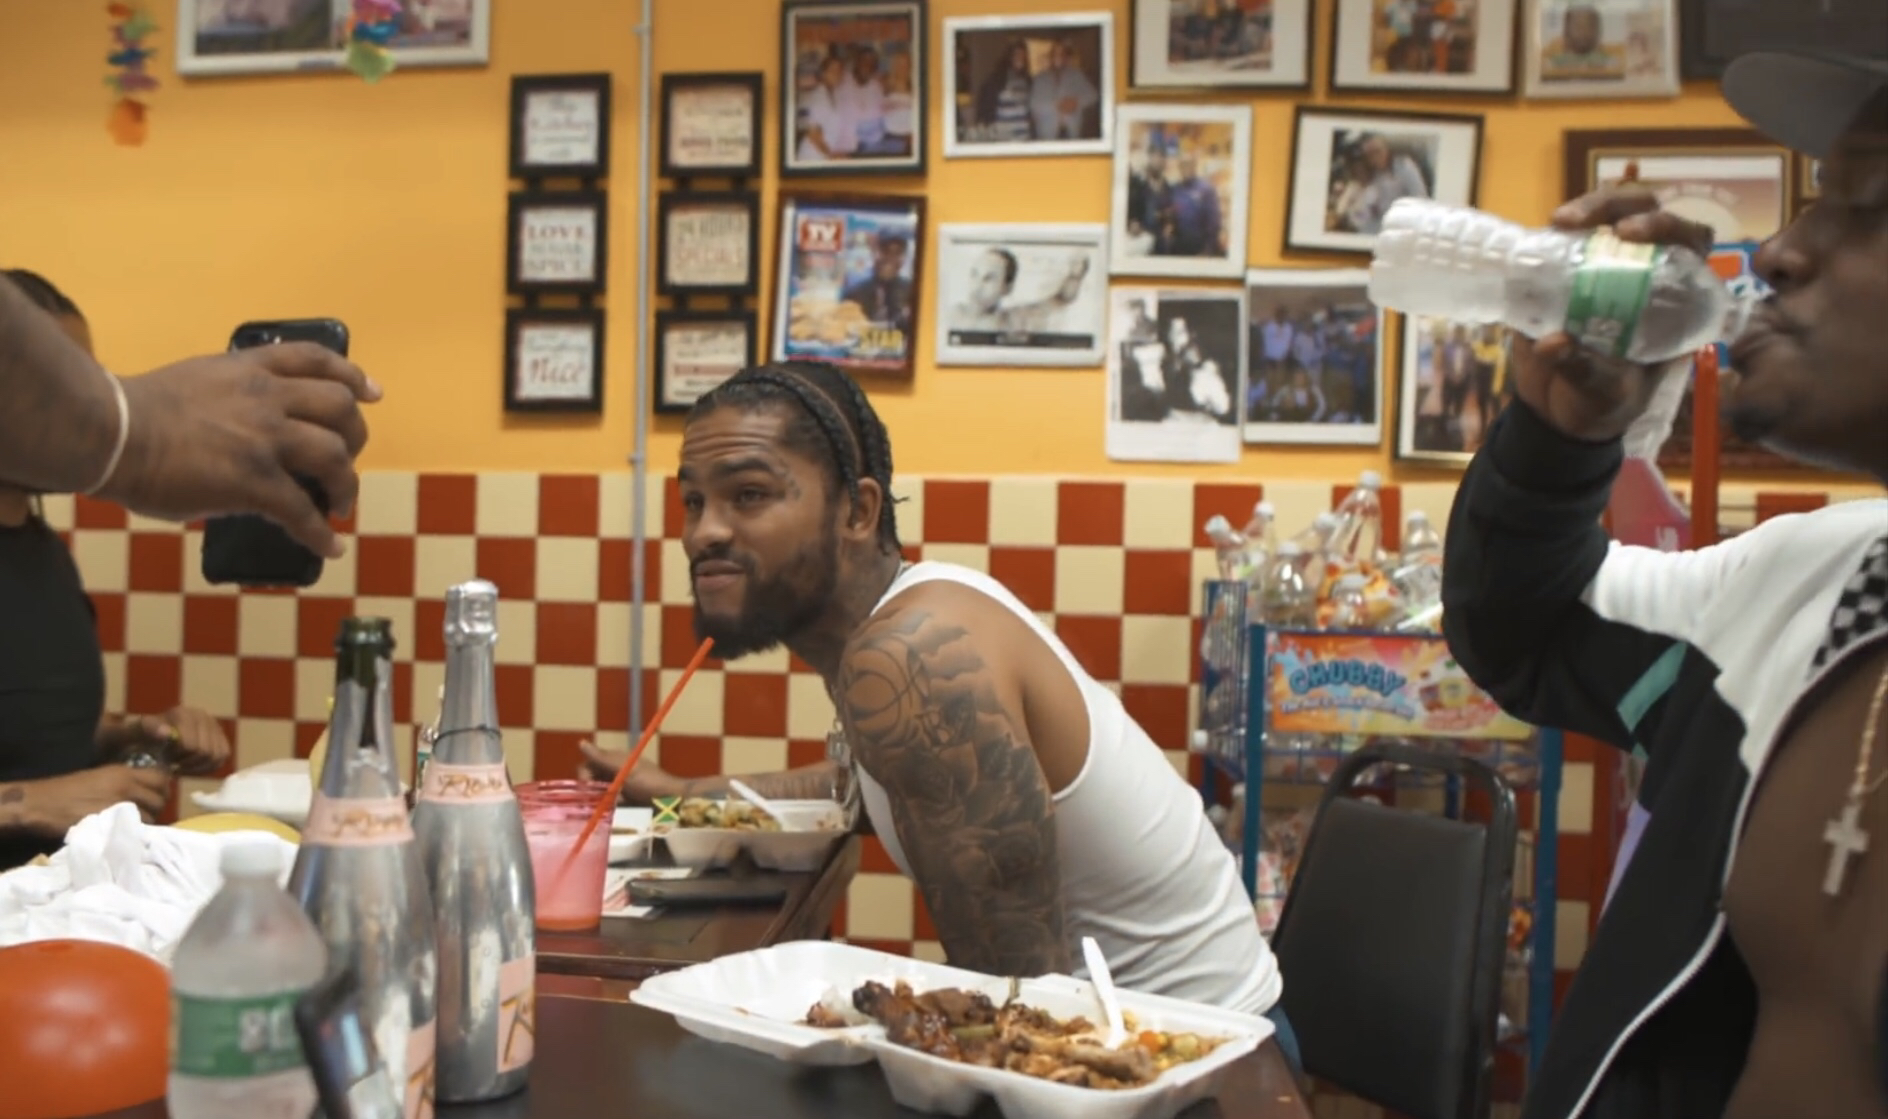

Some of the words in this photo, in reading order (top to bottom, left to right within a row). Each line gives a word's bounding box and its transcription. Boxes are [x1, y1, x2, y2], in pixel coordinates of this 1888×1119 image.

[527, 224, 584, 240] LOVE
[807, 222, 837, 243] TV
[1290, 661, 1407, 697] CHUBBY
